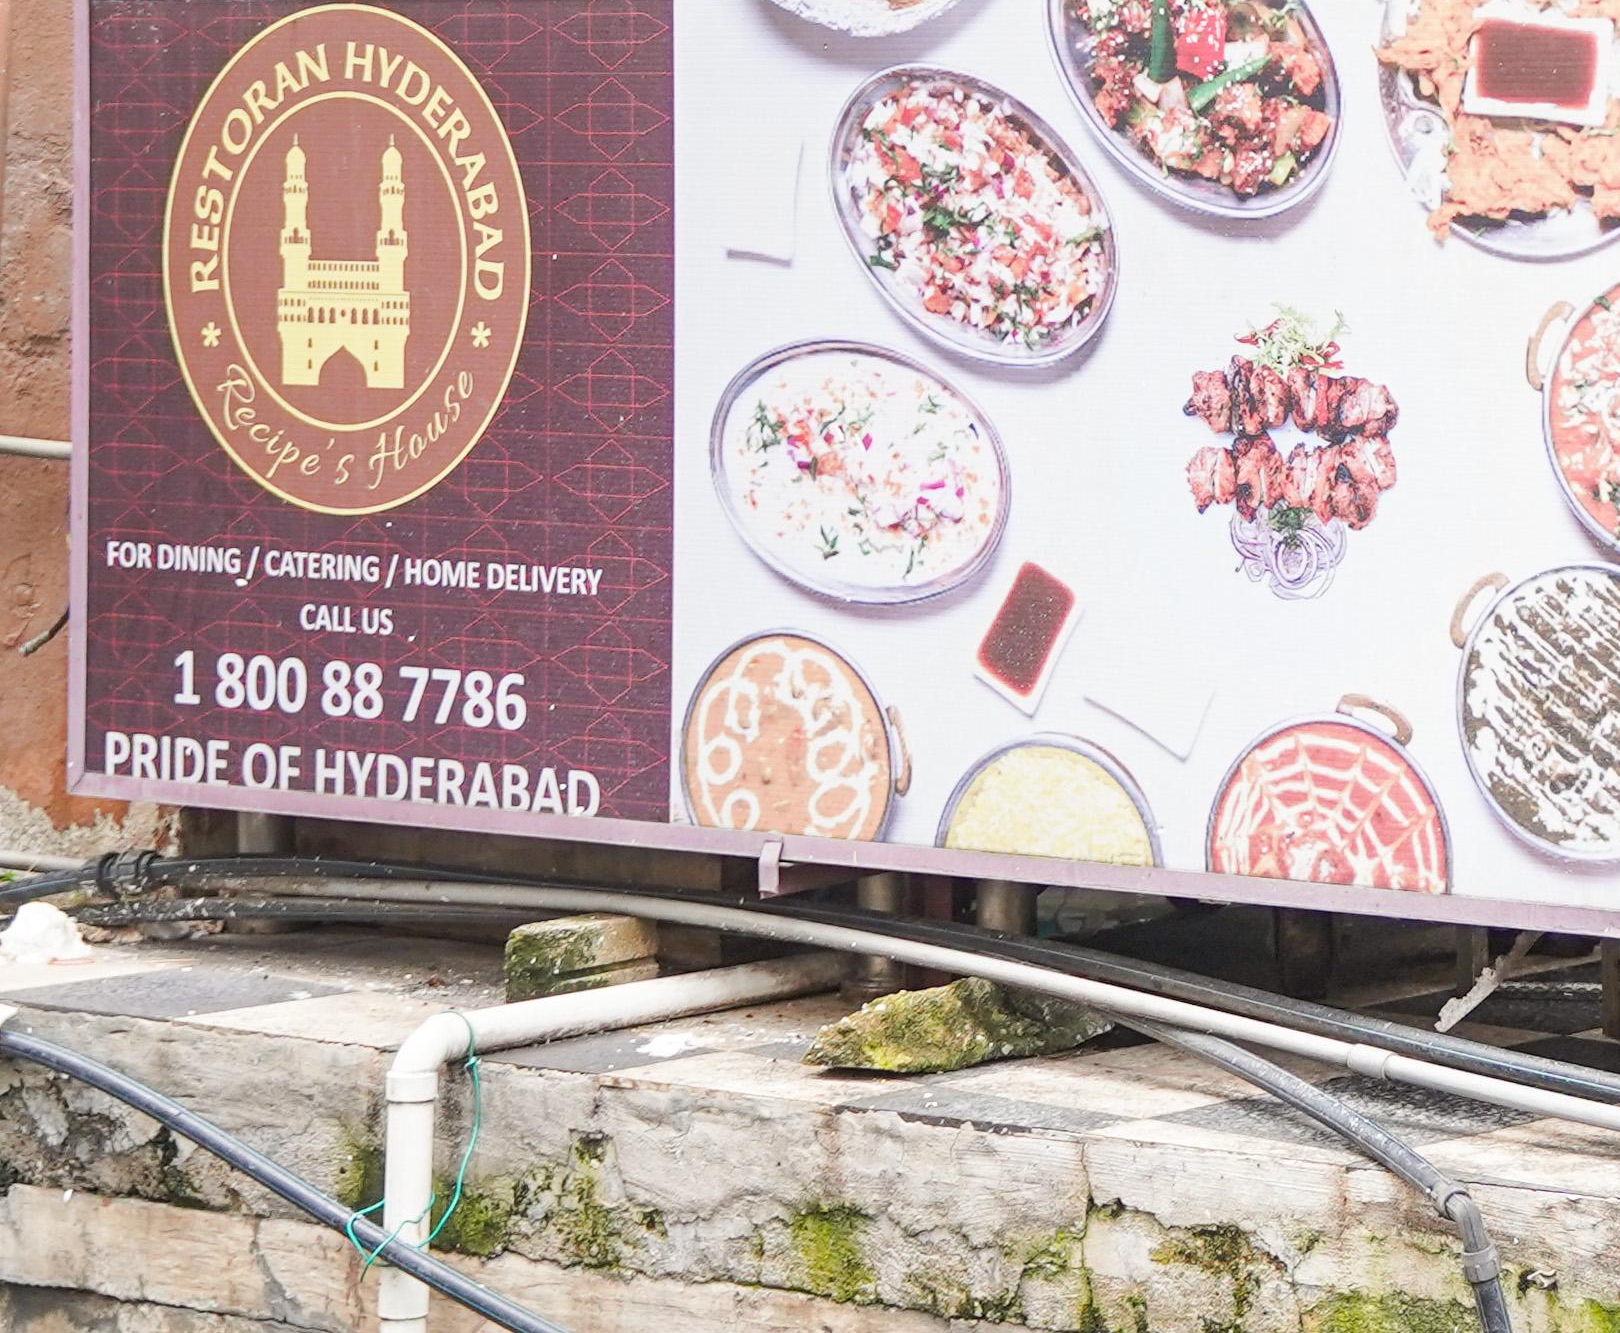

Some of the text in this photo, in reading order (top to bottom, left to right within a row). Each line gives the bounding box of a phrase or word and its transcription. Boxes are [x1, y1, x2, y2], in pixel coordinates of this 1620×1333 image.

[189, 41, 506, 302] RESTORAN HYDERABAD
[217, 363, 475, 490] Recipe's House
[107, 541, 151, 569] FOR
[158, 542, 242, 575] DINING
[264, 549, 381, 584] CATERING
[404, 558, 480, 590] HOME
[487, 563, 603, 597] DELIVERY
[300, 603, 394, 635] CALL US
[174, 649, 528, 731] 1 800 88 7786
[104, 731, 602, 818] PRIDE OF HYDERABAD
